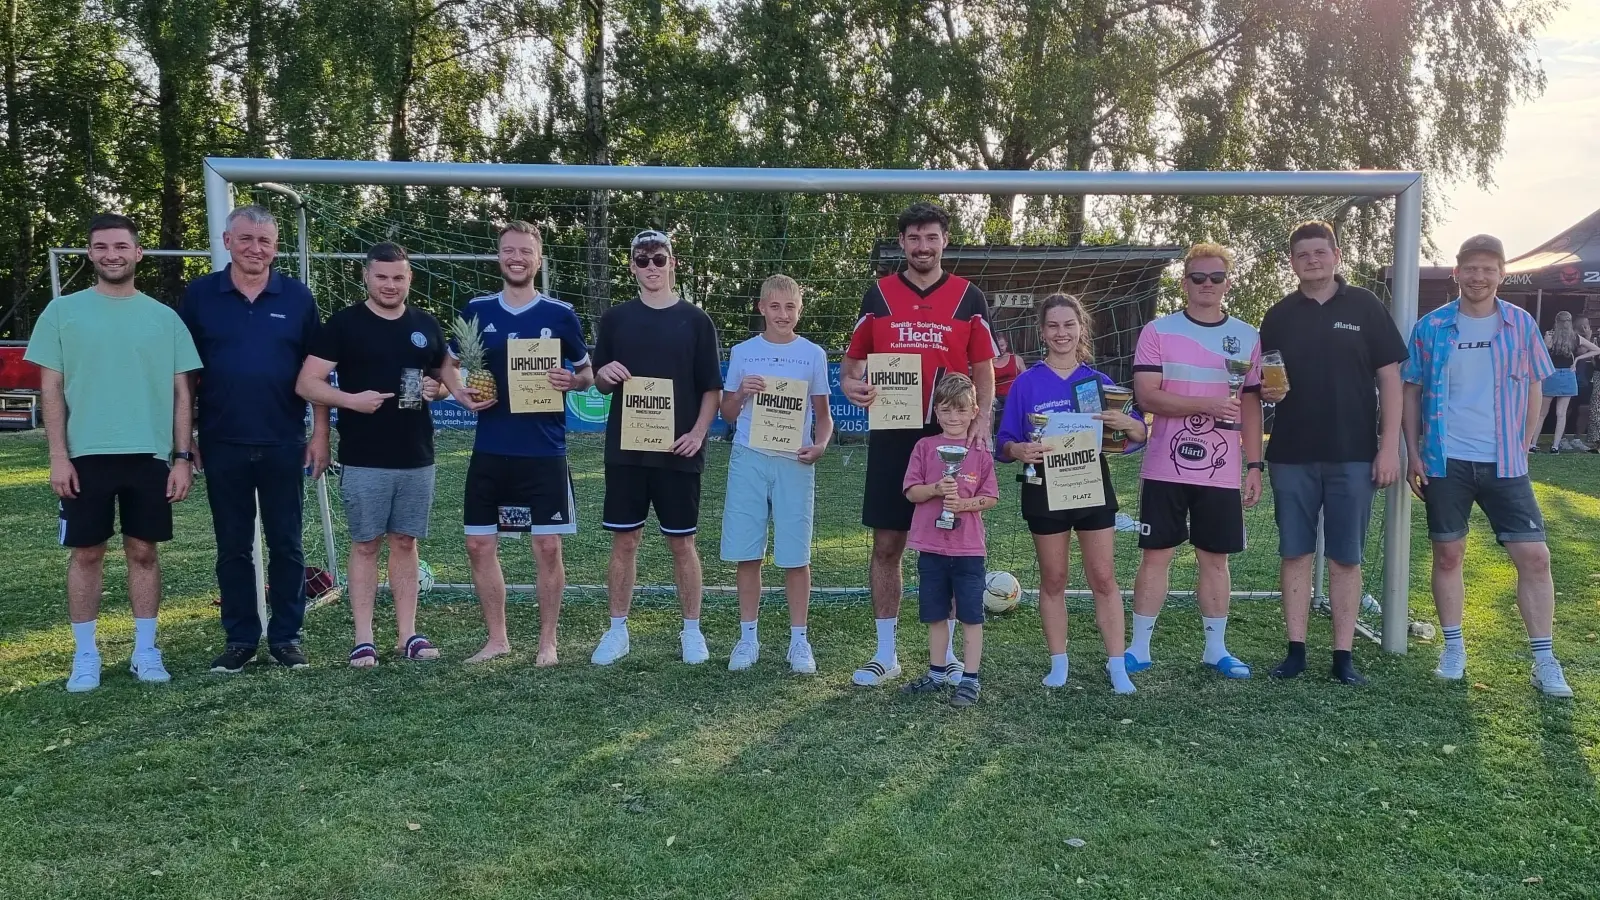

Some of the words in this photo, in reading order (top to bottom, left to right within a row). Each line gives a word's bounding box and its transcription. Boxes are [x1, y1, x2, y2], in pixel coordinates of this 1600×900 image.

[998, 294, 1030, 305] VfB
[890, 321, 912, 329] Sanitär
[916, 321, 953, 332] Solartechnik
[1333, 321, 1361, 332] Markus
[898, 327, 943, 344] Hecht
[510, 356, 557, 371] URKUNDE
[871, 371, 918, 386] URKUNDE
[625, 394, 671, 410] URKUNDE
[756, 392, 804, 411] URKUNDE
[1033, 399, 1072, 412] Gastwirtschaft
[772, 436, 791, 444] PLATZ
[1180, 436, 1209, 446] METZGEREI
[1181, 445, 1204, 458] Härtl
[1046, 448, 1096, 469] URKUNDE
[1072, 492, 1092, 500] PLATZ
